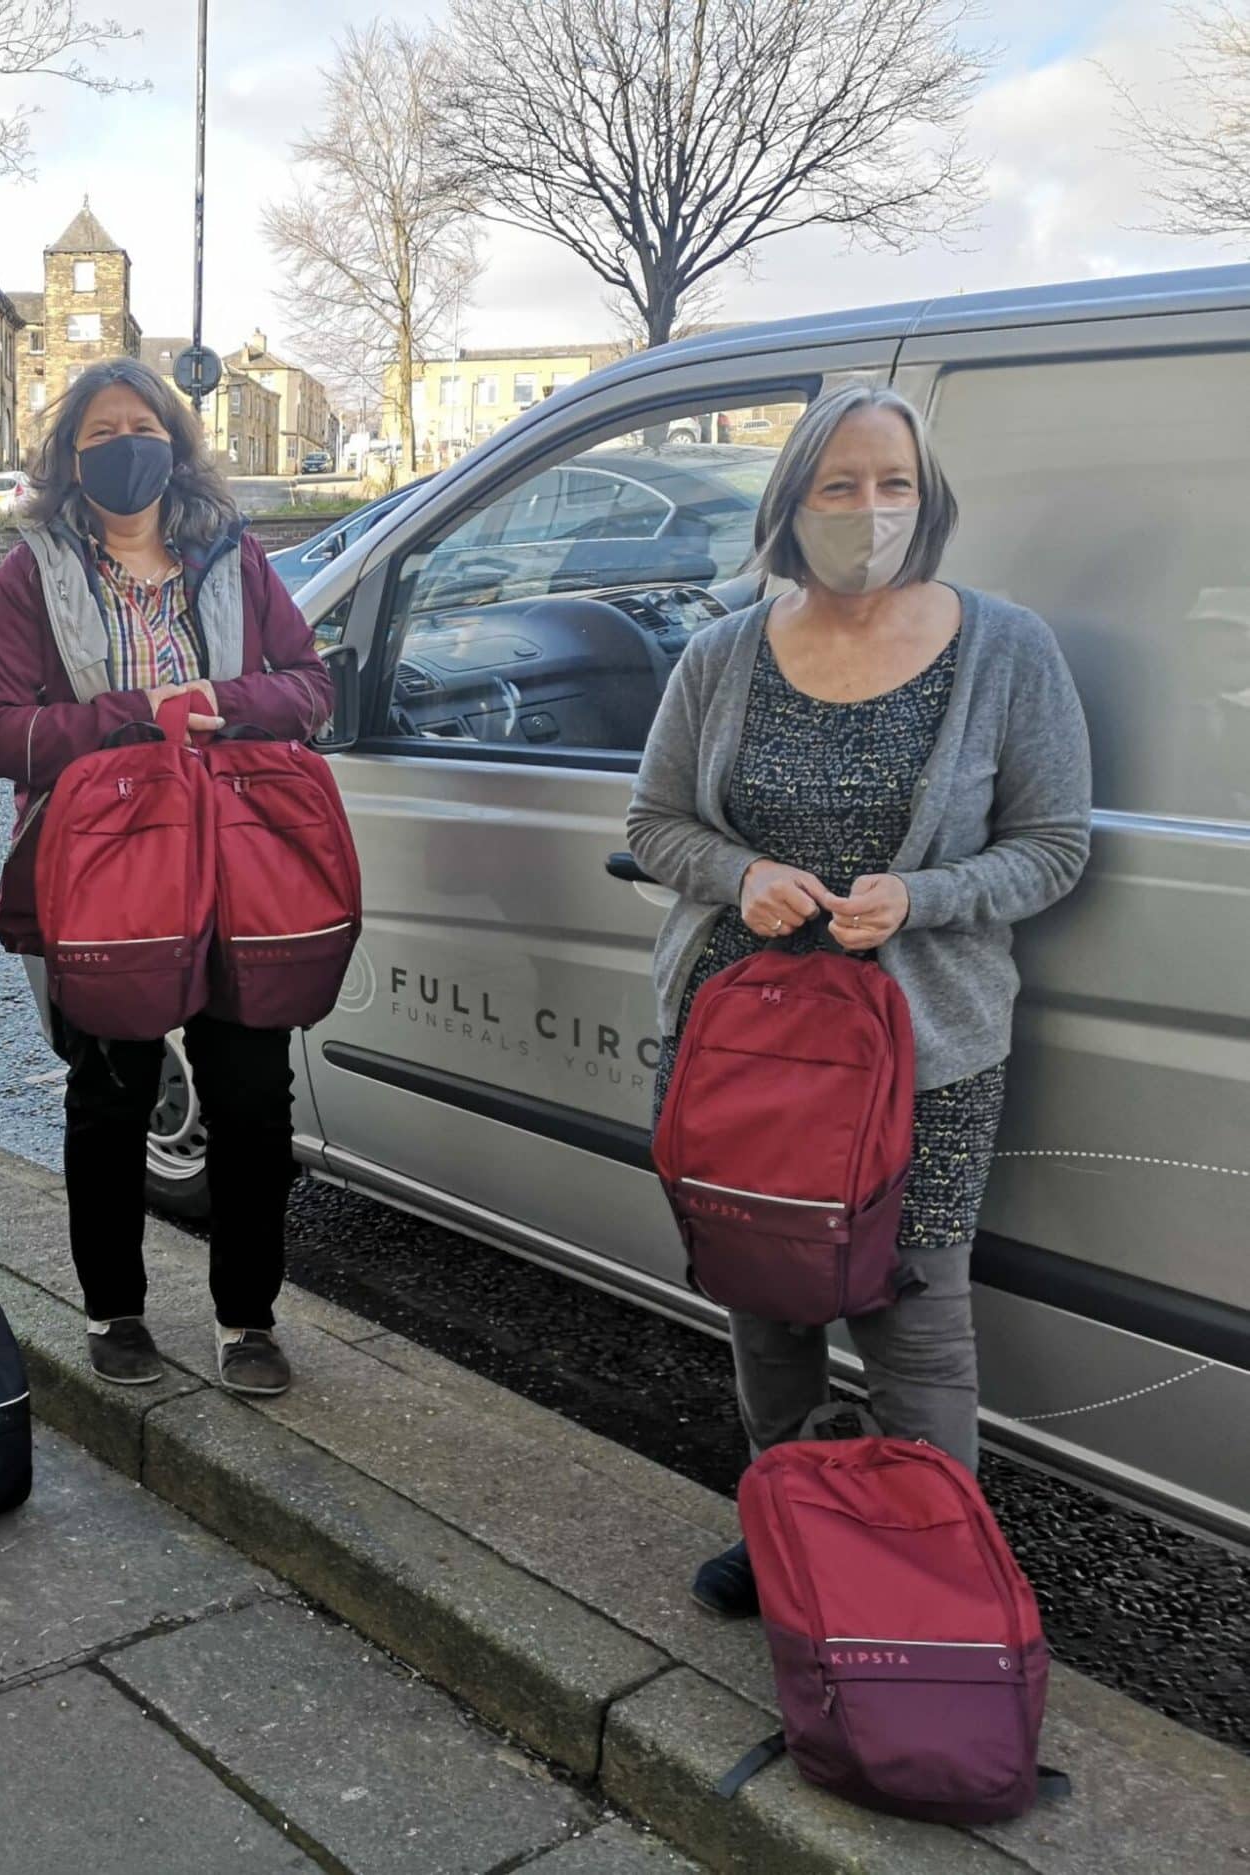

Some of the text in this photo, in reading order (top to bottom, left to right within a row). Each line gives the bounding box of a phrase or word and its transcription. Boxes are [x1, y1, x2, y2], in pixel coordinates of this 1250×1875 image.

[57, 952, 111, 962] KIPSTA
[391, 967, 661, 1070] FULL CIRC
[564, 1054, 645, 1090] YOUR
[690, 1198, 751, 1220] KIPSTA
[830, 1652, 910, 1665] KIPSTA
